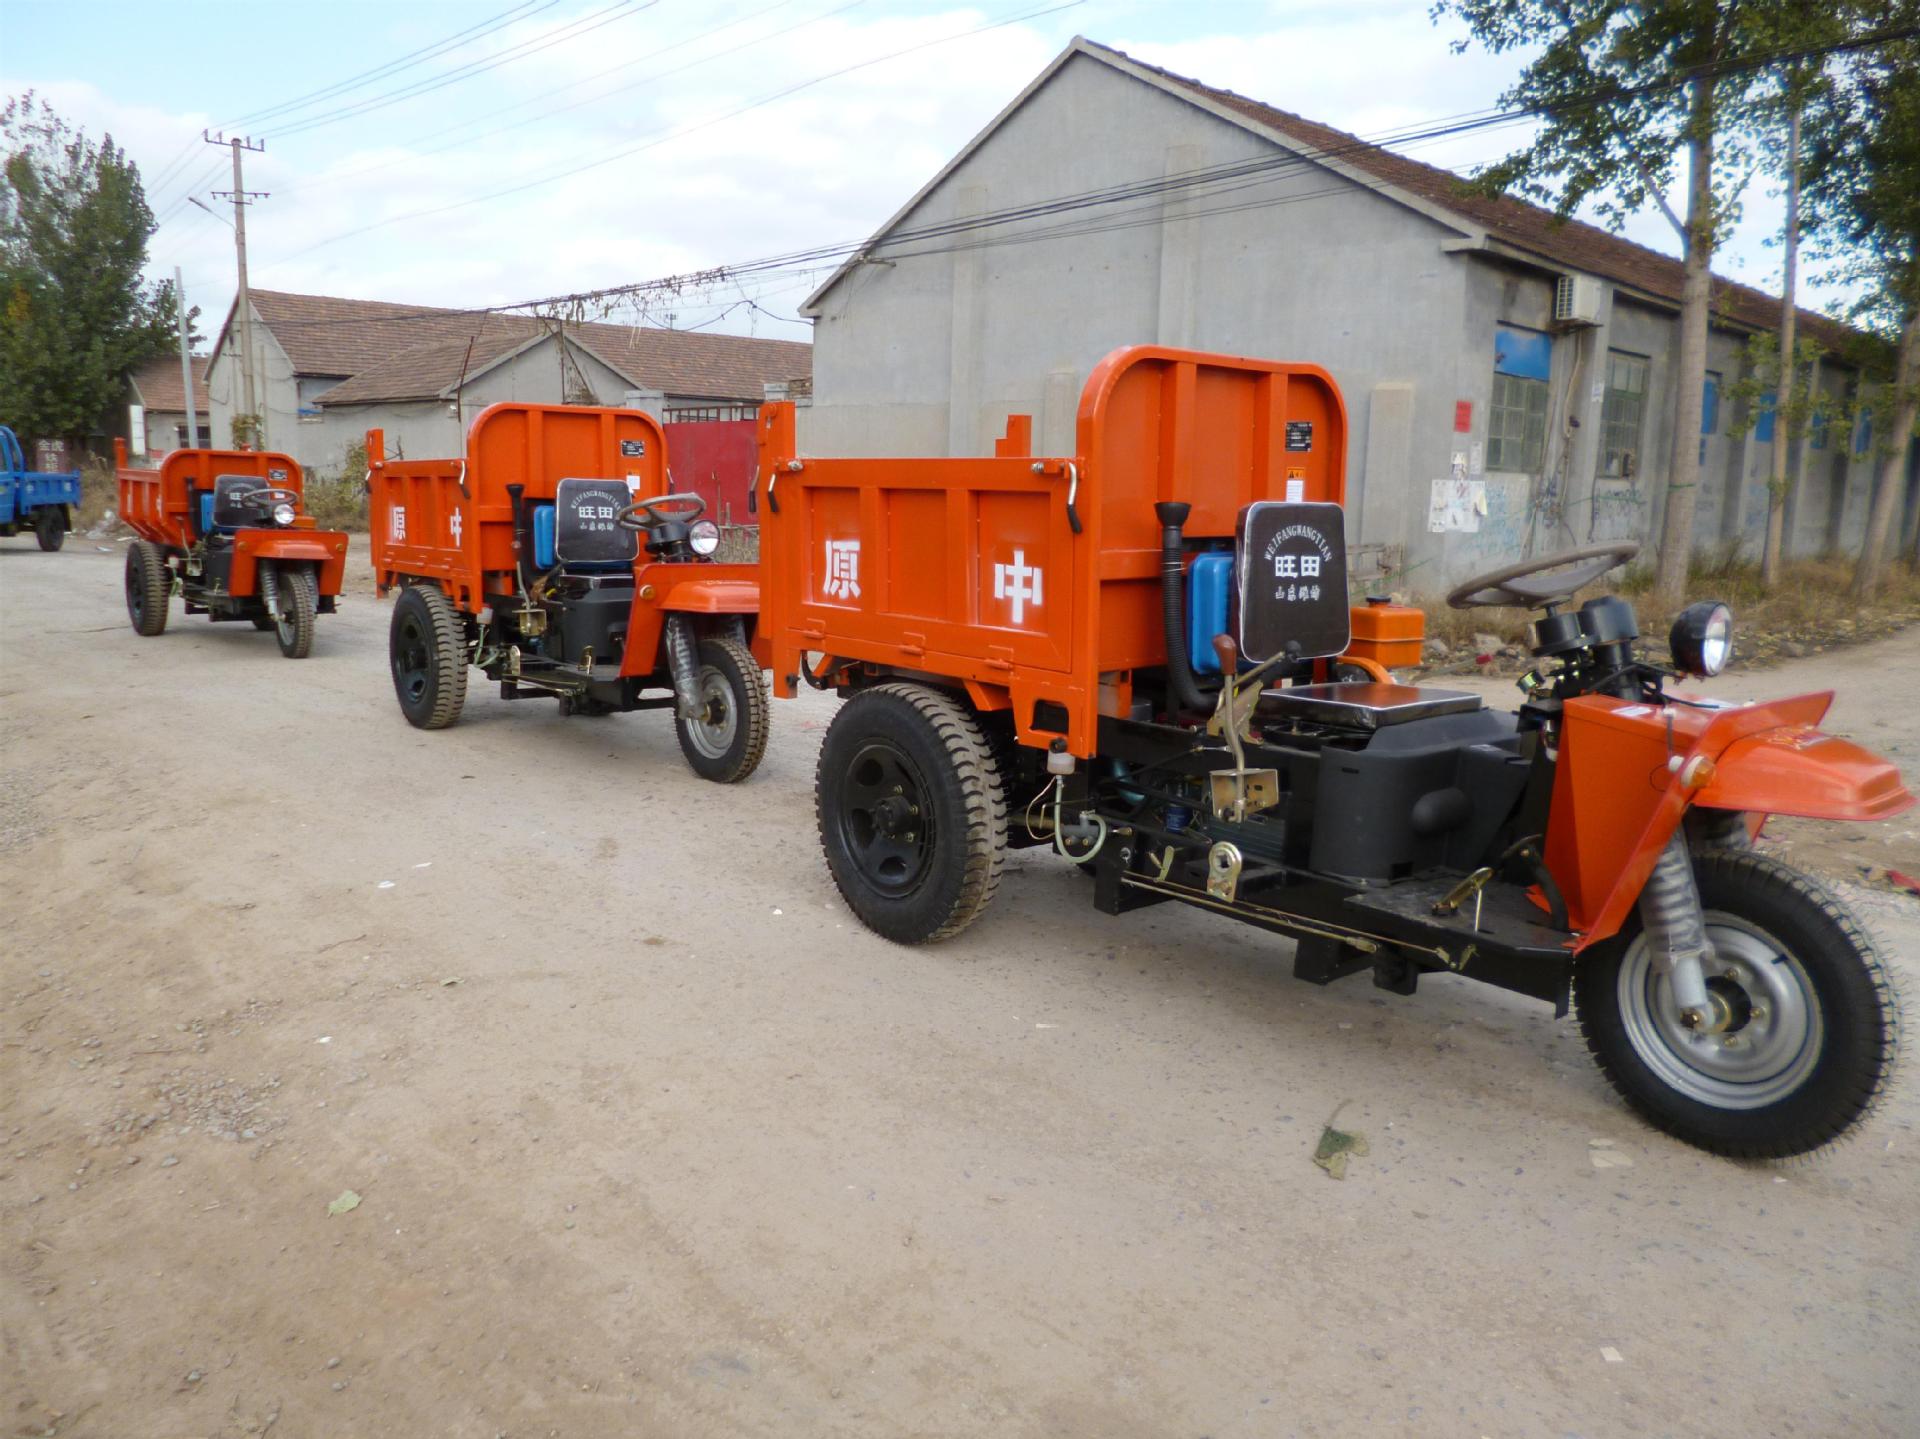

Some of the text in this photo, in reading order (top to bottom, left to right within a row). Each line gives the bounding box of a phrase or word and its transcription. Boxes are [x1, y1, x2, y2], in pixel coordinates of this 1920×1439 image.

[450, 506, 462, 547] 中
[578, 506, 613, 519] 旺田
[1264, 524, 1332, 562] WEIFANGWANGTIAN
[823, 540, 1042, 623] 原 中
[1275, 555, 1320, 578] 旺田
